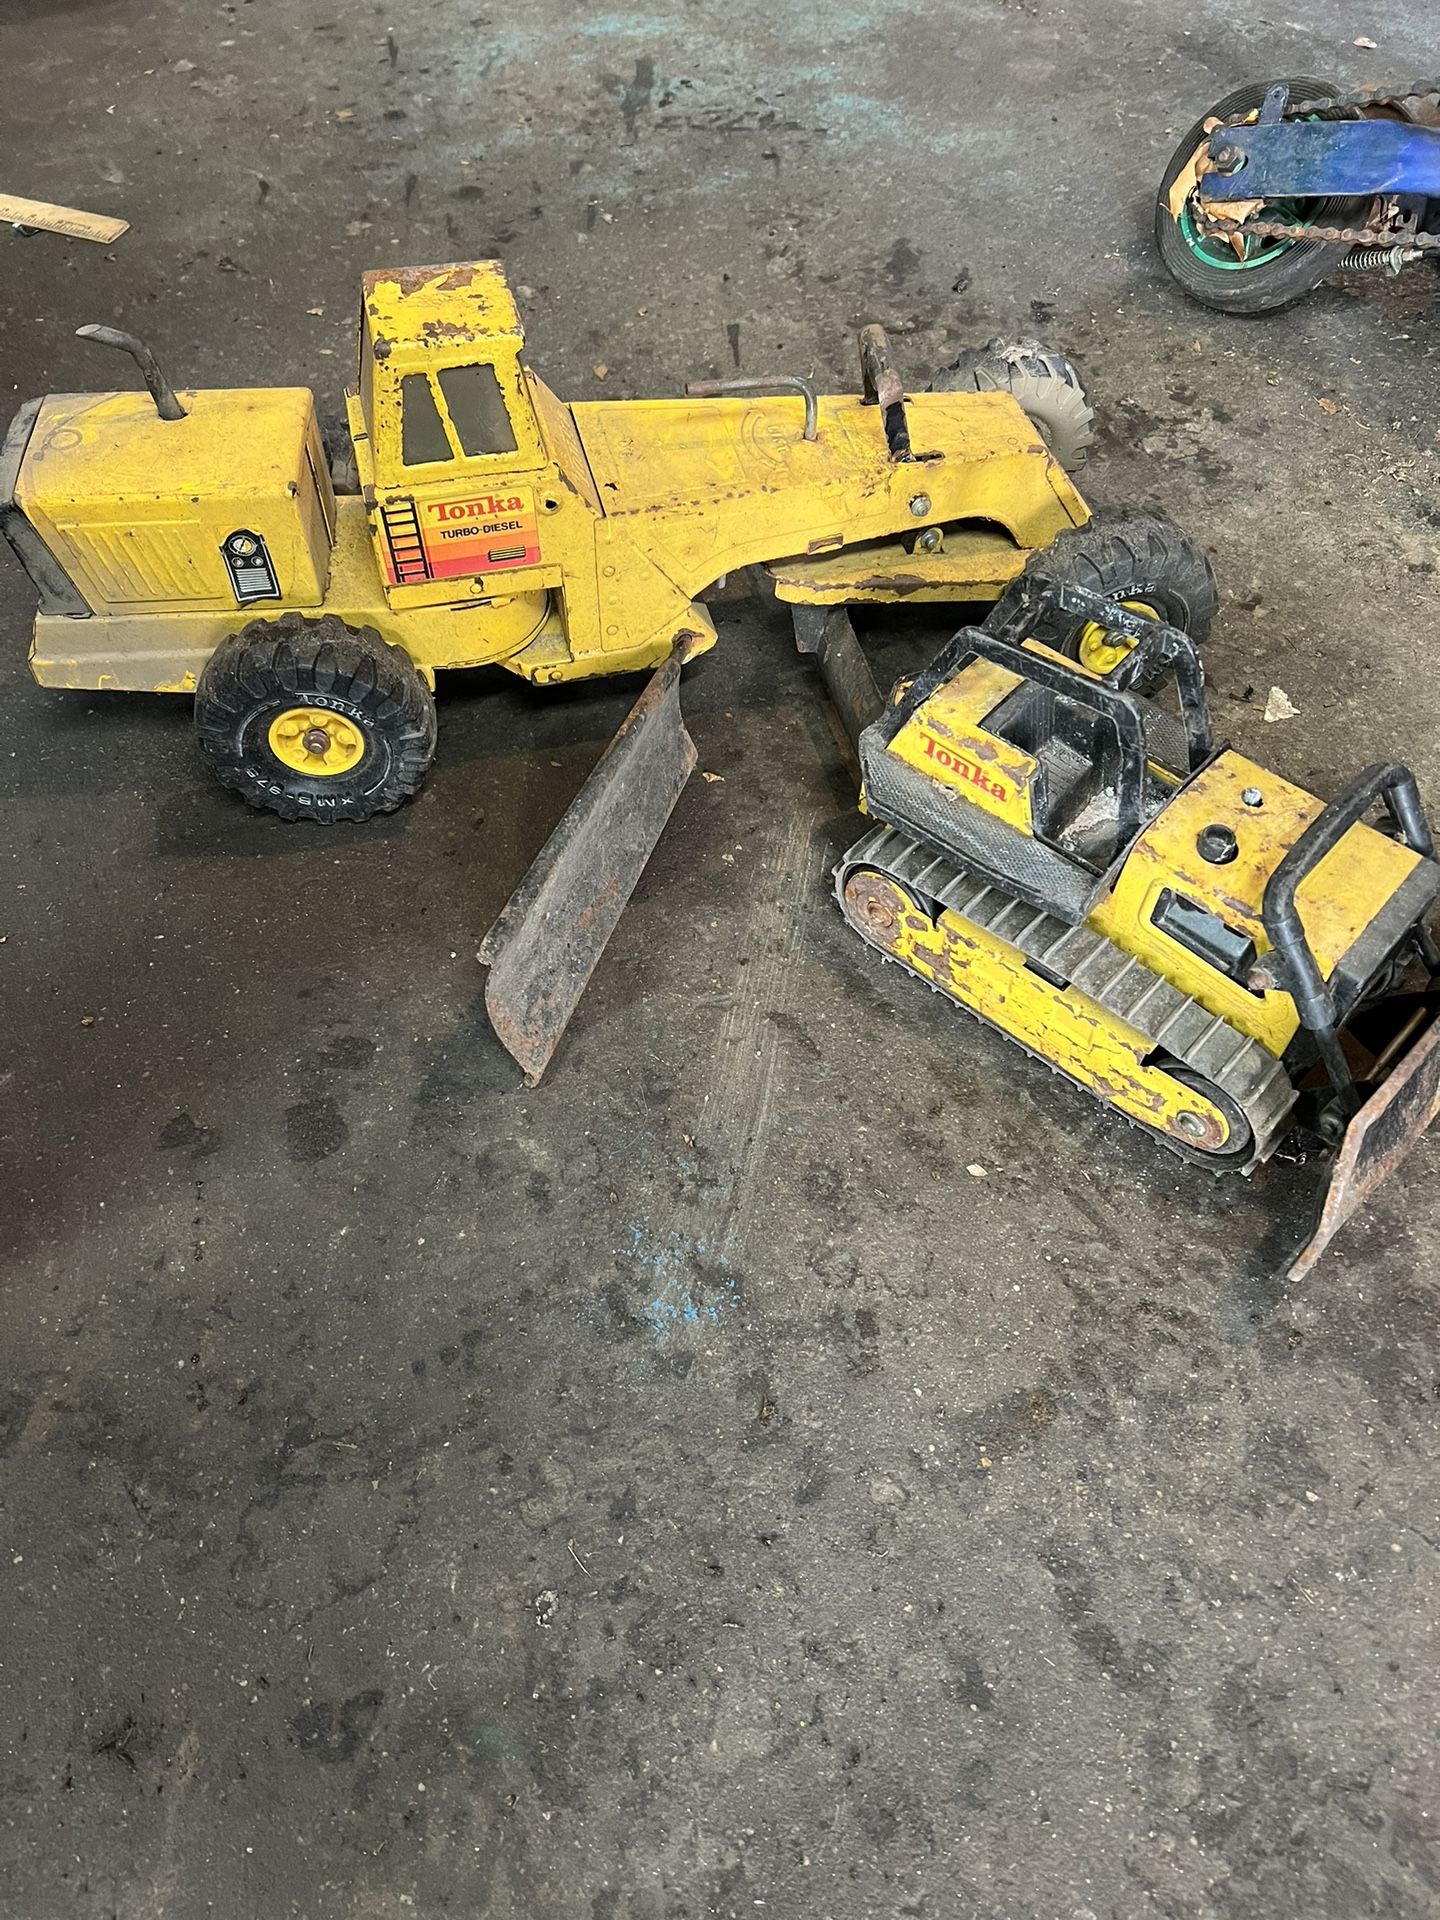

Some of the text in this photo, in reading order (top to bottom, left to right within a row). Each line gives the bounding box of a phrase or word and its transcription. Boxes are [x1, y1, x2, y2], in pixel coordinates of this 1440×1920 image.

[427, 495, 525, 522] Tonka
[440, 520, 523, 539] TURBO-DIESEL
[1105, 582, 1157, 601] nka
[294, 691, 376, 728] Tonka
[919, 731, 1008, 803] Tonka
